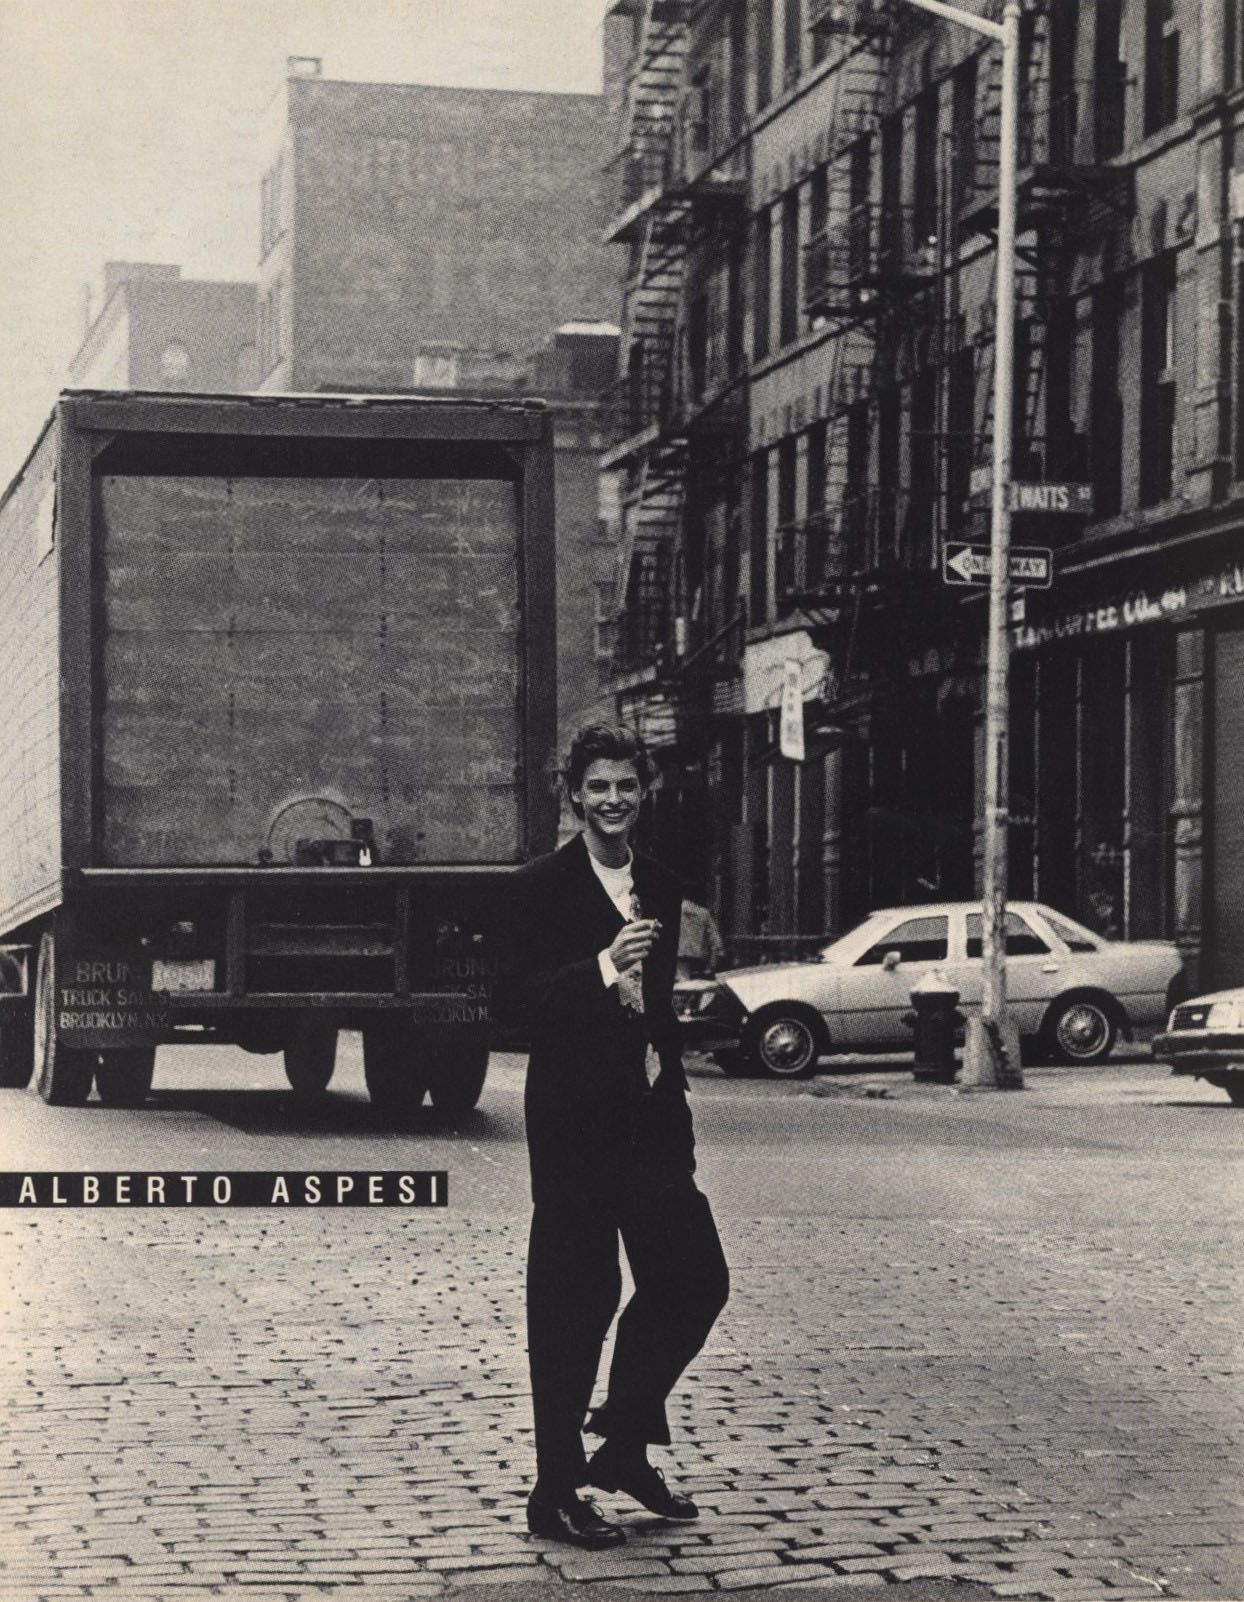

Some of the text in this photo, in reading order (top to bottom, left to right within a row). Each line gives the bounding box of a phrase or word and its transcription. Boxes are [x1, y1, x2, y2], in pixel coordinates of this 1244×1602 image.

[1020, 486, 1069, 510] WATTS
[961, 556, 1043, 574] ONE WAY
[60, 989, 112, 1006] TRUCK
